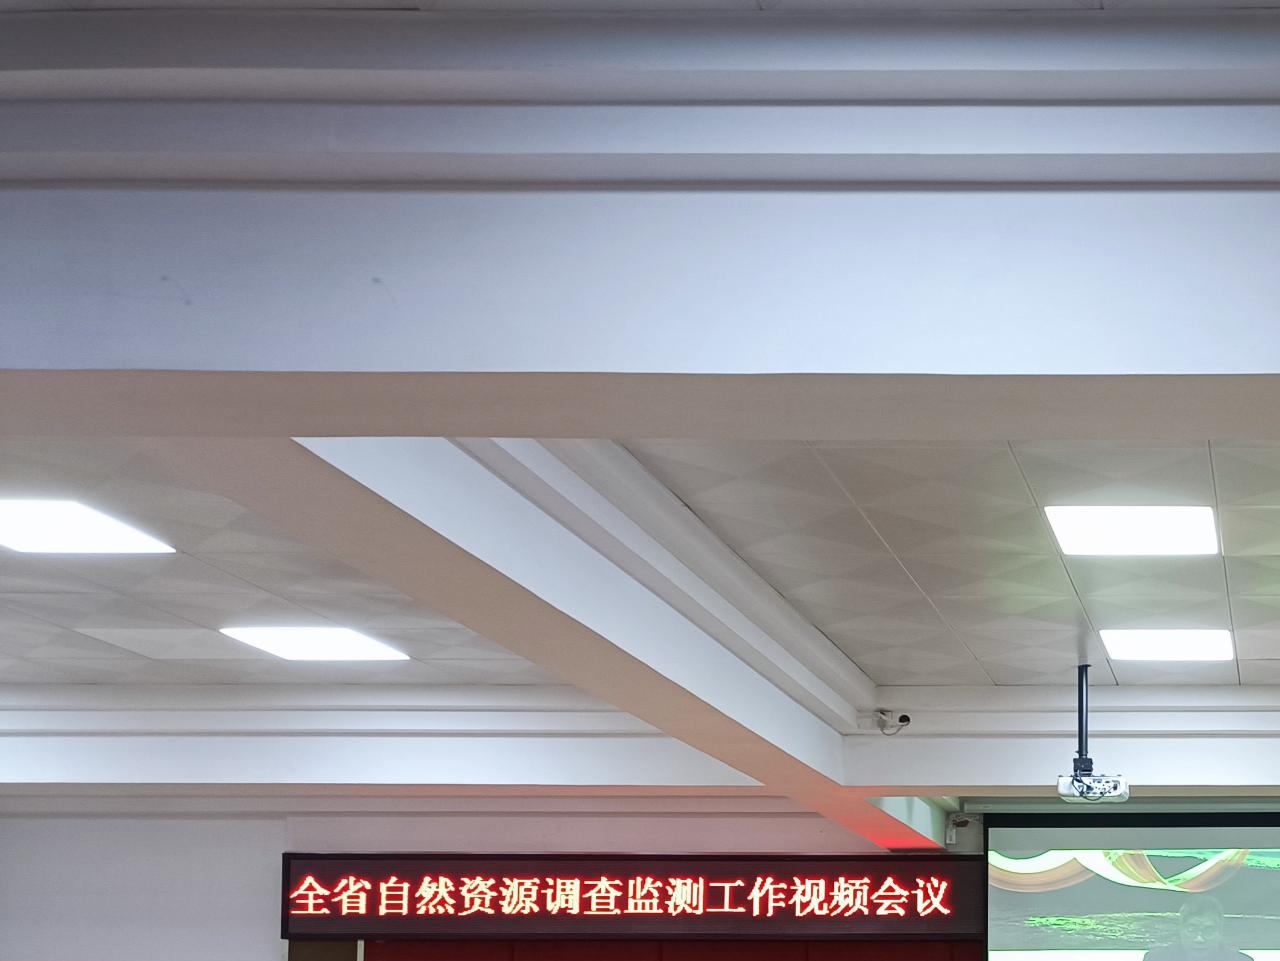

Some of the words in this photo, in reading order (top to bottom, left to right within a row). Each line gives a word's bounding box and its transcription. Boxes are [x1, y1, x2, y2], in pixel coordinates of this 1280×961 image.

[289, 875, 952, 916] 全省自然资源调查监测工作视频会议
